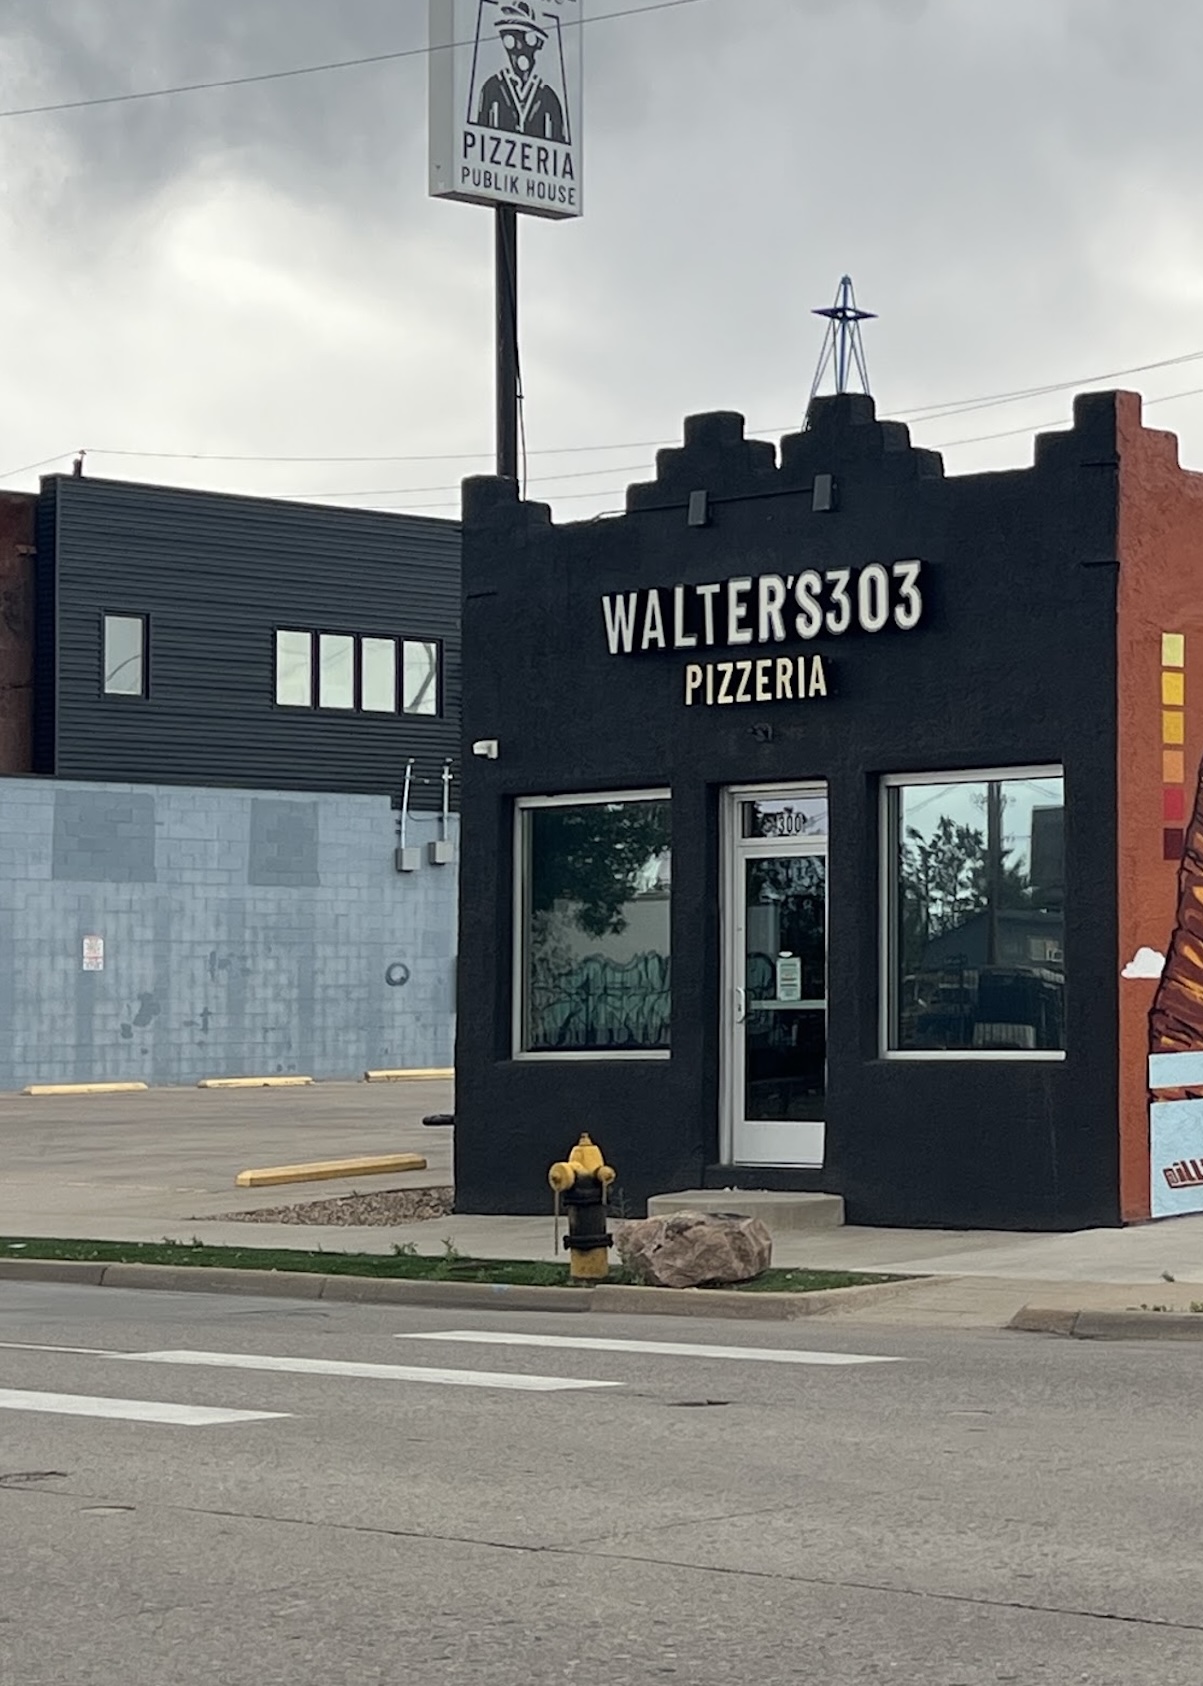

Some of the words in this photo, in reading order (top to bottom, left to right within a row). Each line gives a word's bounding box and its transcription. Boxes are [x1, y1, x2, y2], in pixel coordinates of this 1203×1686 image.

[463, 131, 575, 181] PIZZERIA
[461, 166, 519, 195] PUBLIK
[526, 179, 576, 206] HOUSE
[685, 655, 828, 706] PIZZERIA
